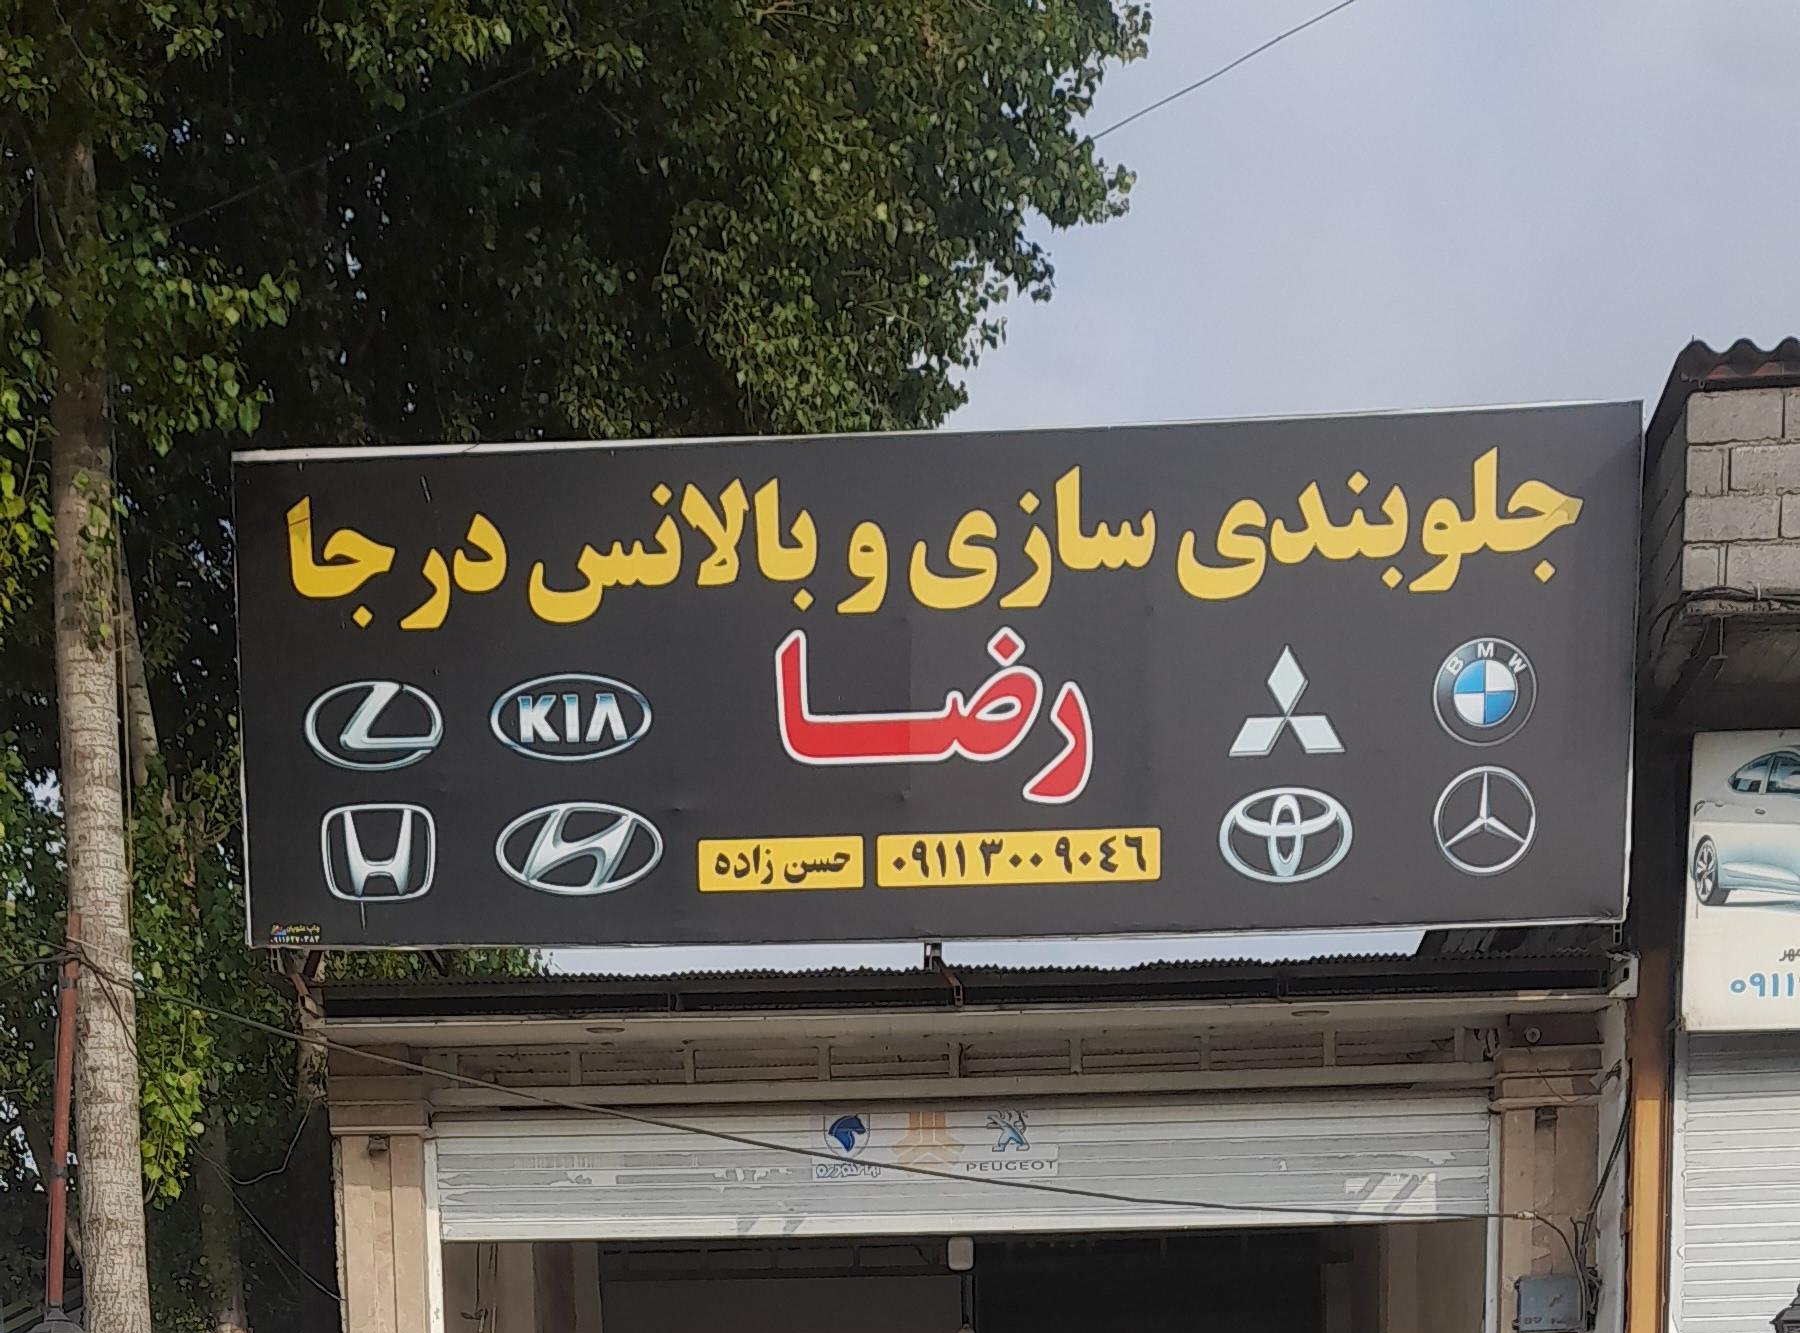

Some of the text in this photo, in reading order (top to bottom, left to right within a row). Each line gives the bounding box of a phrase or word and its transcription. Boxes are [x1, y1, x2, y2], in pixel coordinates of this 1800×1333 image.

[528, 477, 818, 625] بالانس
[836, 520, 889, 615] و
[908, 465, 1157, 610] سازی
[1176, 445, 1584, 601] جلوبندی
[1445, 641, 1528, 677] BMW
[517, 693, 629, 744] KIA
[775, 626, 1093, 804] رضا
[713, 844, 851, 885] حسن زاده
[966, 1160, 1057, 1172] PEUGEOT
